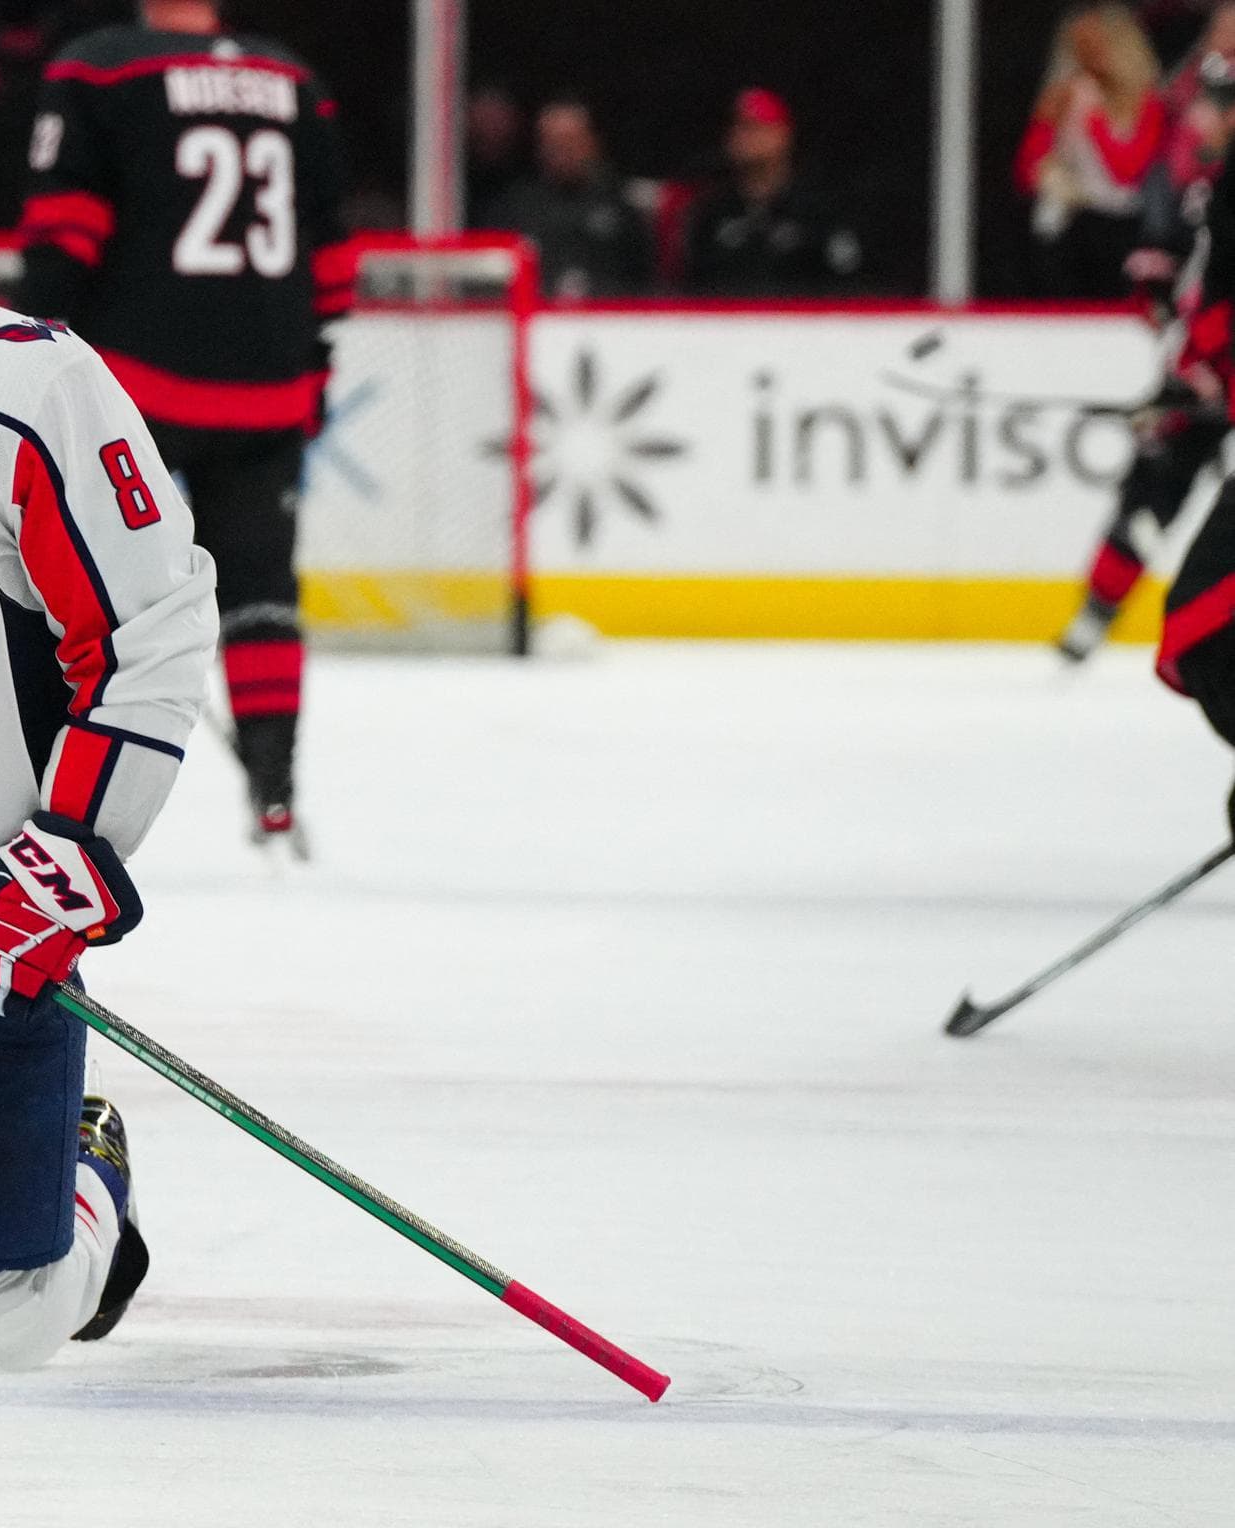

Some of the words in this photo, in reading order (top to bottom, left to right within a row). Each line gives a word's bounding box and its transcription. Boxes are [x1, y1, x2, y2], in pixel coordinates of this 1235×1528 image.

[172, 125, 297, 278] 23
[752, 368, 1138, 490] inviso
[99, 438, 161, 530] 8
[8, 832, 94, 912] CM
